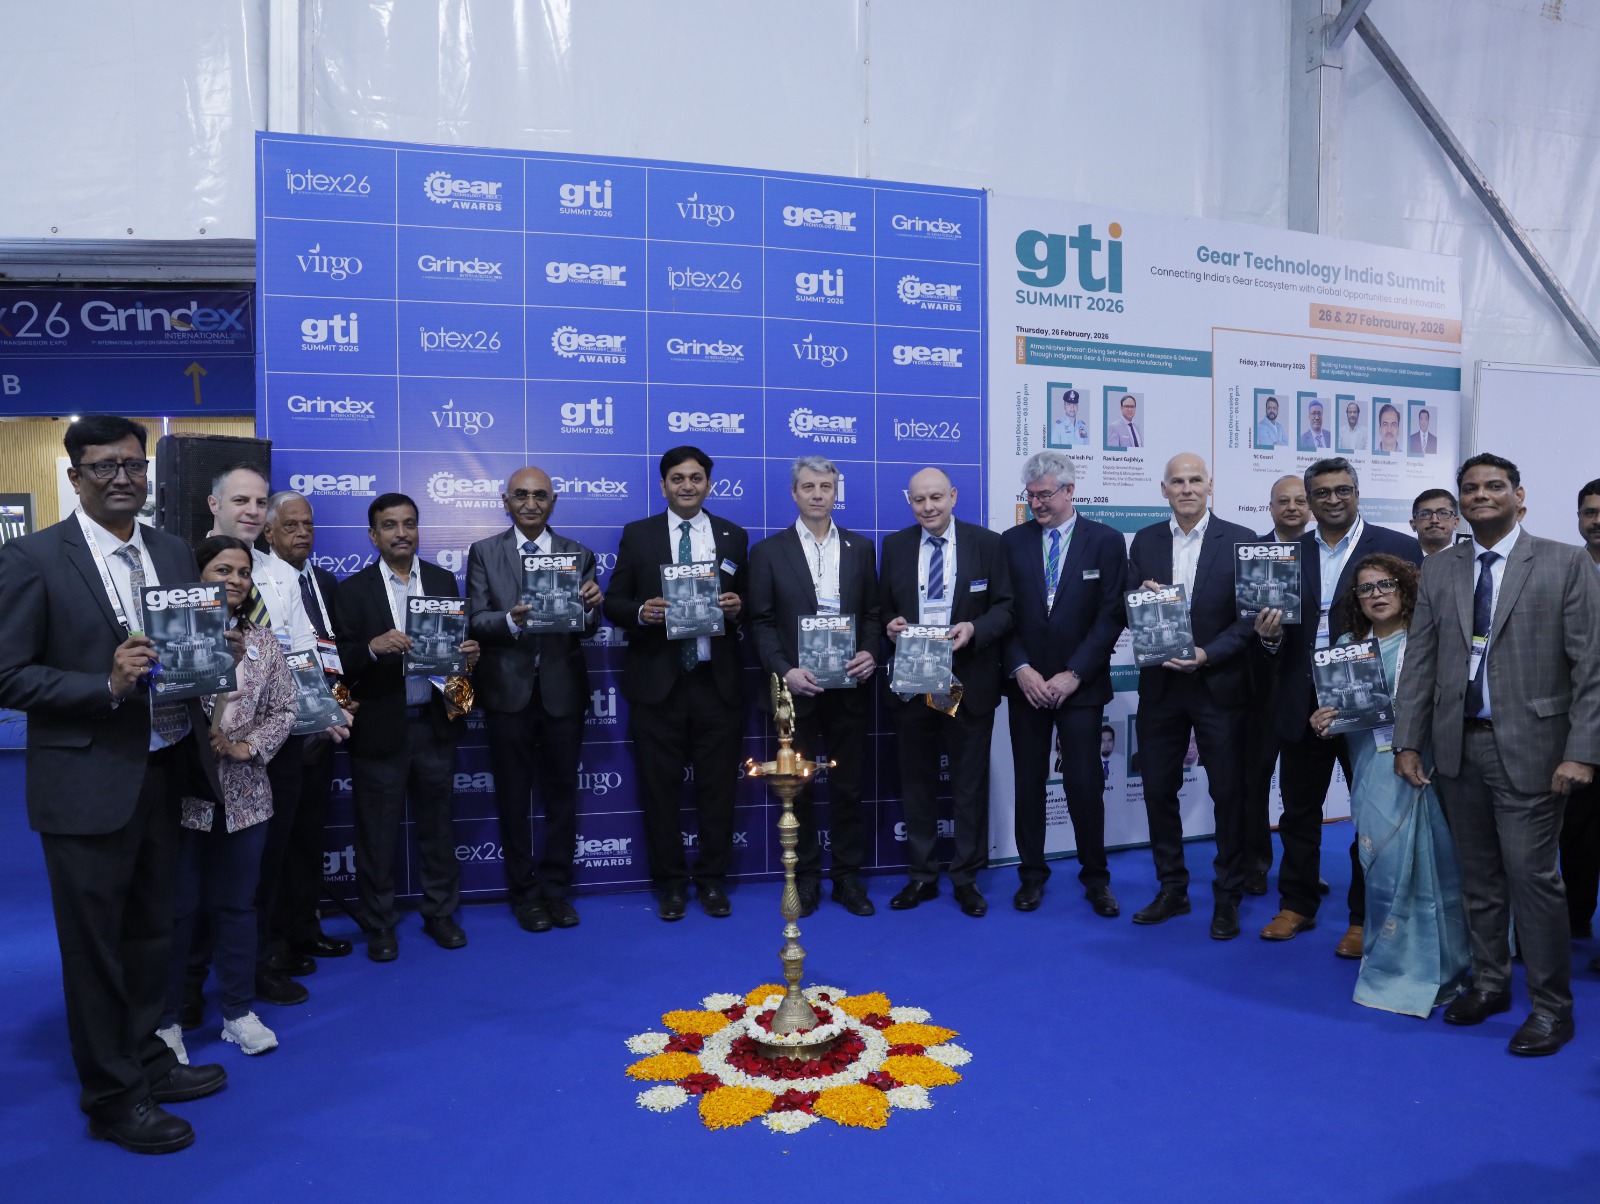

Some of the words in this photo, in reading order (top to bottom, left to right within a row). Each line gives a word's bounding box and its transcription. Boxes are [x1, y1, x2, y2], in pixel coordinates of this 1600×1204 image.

[286, 168, 371, 194] iptex26
[433, 176, 502, 196] gear
[559, 179, 612, 210] gti
[452, 201, 502, 211] AWARDS
[559, 208, 591, 217] SUMMIT
[594, 209, 613, 218] 2026
[676, 192, 735, 228] virgo
[783, 205, 857, 227] gear
[892, 214, 962, 235] Grindex
[296, 243, 363, 280] virgo
[418, 254, 502, 275] Grindex
[1015, 222, 1123, 294] gti
[546, 262, 626, 284] gear
[668, 266, 742, 290] iptex26
[1196, 246, 1240, 266] Gear
[1244, 251, 1341, 284] Technology
[1344, 264, 1384, 286] India
[1386, 271, 1446, 294] Summit
[796, 268, 844, 297] gti
[904, 281, 962, 298] gear
[1150, 266, 1201, 282] Connecting
[1204, 272, 1231, 283] India's
[1232, 276, 1252, 286] Gear
[1254, 278, 1298, 292] Ecosystem
[1299, 284, 1315, 293] with
[1316, 286, 1342, 296] Global
[1344, 290, 1392, 303] Opportunities
[1394, 296, 1408, 304] and
[796, 295, 825, 304] SUMMIT
[826, 296, 844, 305] 2026
[920, 302, 962, 312] AWARDS
[1015, 289, 1083, 309] SUMMIT
[1086, 296, 1124, 314] 2026
[80, 301, 245, 332] Grindex
[1318, 309, 1332, 322] 26
[1334, 311, 1342, 322] &
[1346, 312, 1358, 324] 27
[1360, 314, 1418, 335] Febrauray,
[1421, 322, 1444, 335] 2026
[165, 332, 230, 340] INTERNATIONAL
[301, 312, 358, 344] gti
[1016, 326, 1050, 336] Thursday,
[1052, 328, 1060, 336] 26
[1060, 329, 1093, 340] February,
[1094, 332, 1109, 340] 2026
[420, 326, 500, 352] iptex26
[559, 329, 626, 350] gear
[666, 338, 744, 356] Grindex
[578, 355, 626, 364] AWARDS
[792, 333, 848, 368] virgo
[892, 344, 962, 366] gear
[1030, 350, 1052, 358] Through
[1054, 352, 1082, 360] Indigenous
[1240, 358, 1258, 368] Friday,
[1266, 361, 1292, 370] February
[2, 375, 21, 394] B
[1024, 384, 1030, 396] pm
[288, 396, 374, 414] Grindex
[560, 396, 613, 426] gti
[431, 399, 494, 435] virgo
[668, 412, 744, 432] gear
[796, 412, 856, 430] gear
[560, 426, 593, 434] SUMMIT
[814, 436, 856, 444] AWARDS
[894, 418, 960, 441] iptex26
[1024, 424, 1030, 436] pm
[290, 474, 376, 496] gear
[435, 476, 504, 497] gear
[550, 476, 628, 494] Grindex
[455, 500, 505, 508] AWARDS
[1096, 510, 1114, 518] utilizing
[1238, 505, 1258, 513] Friday,
[1238, 545, 1294, 560] gear
[524, 556, 576, 572] gear
[664, 562, 714, 580] gear
[146, 586, 220, 611] gear
[410, 598, 465, 614] gear
[1128, 587, 1180, 608] gear
[800, 616, 850, 631] gear
[900, 626, 950, 638] gear
[1314, 642, 1372, 666] gear
[589, 686, 616, 718] ti
[577, 762, 622, 796] irgo
[324, 844, 356, 874] gt
[586, 858, 632, 868] AWARDS
